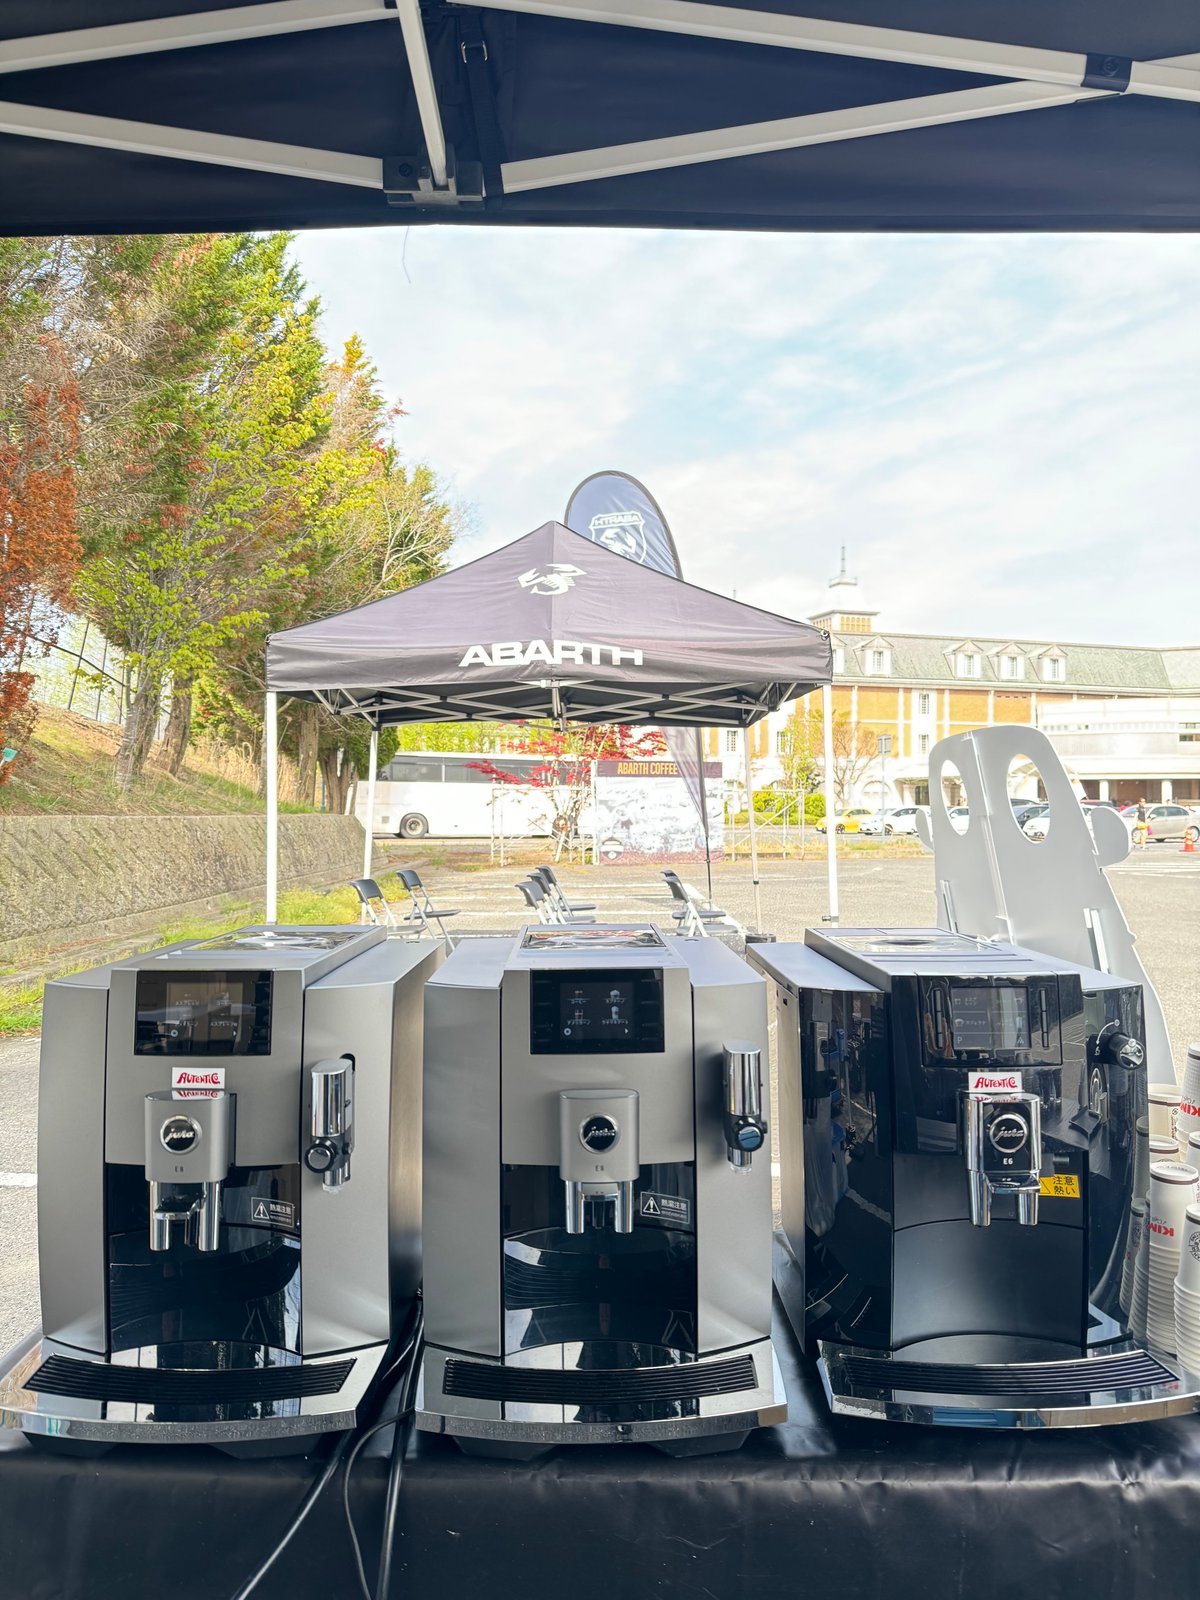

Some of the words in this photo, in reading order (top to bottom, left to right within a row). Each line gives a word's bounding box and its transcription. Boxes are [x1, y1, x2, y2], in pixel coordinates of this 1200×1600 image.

[458, 639, 643, 667] ABARTH
[617, 762, 648, 775] ABARTH
[650, 763, 678, 775] COFFEE
[1003, 1157, 1014, 1165] E6
[1053, 1175, 1075, 1186] 注意
[1054, 1185, 1076, 1195] 熱い
